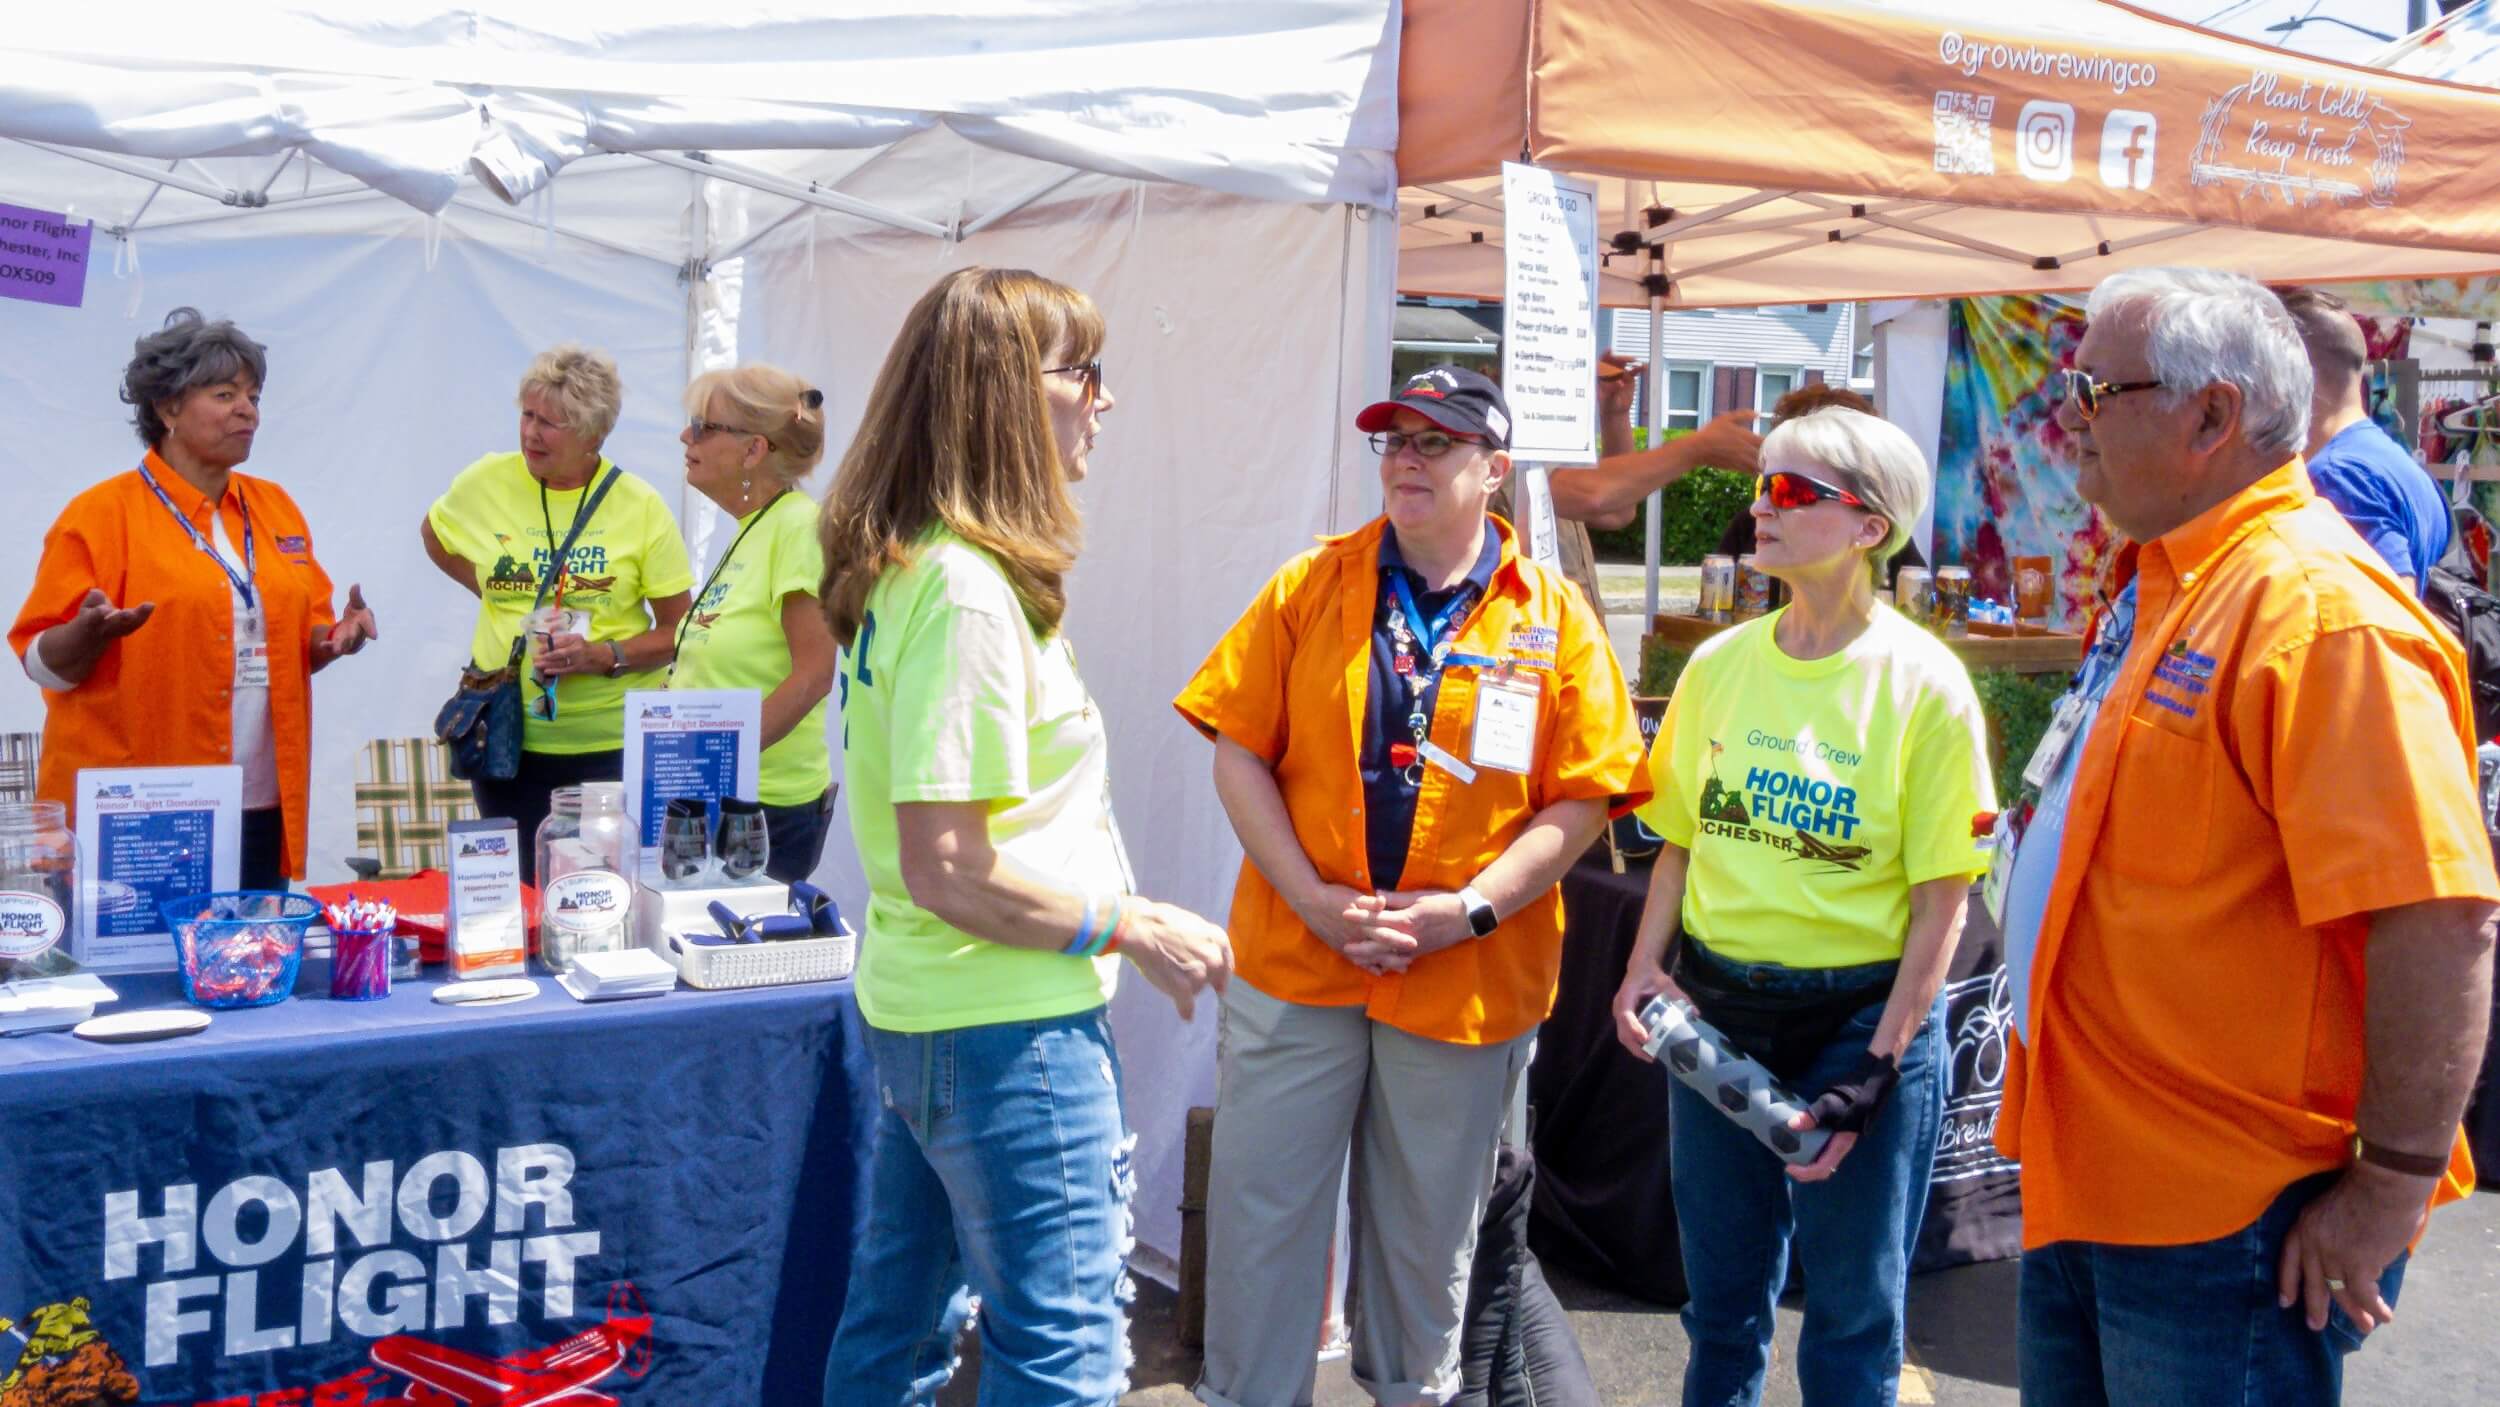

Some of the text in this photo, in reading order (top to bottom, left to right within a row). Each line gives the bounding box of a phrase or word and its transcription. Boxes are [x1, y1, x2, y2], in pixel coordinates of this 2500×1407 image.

[1940, 31, 2157, 95] @growbrewingco
[2247, 71, 2368, 120] Plant Cold
[2245, 119, 2354, 174] Reap Fresh
[1565, 198, 1577, 212] GO
[32, 219, 77, 238] Flight
[57, 247, 81, 263] Inc
[1515, 320, 1532, 331] Power
[532, 546, 606, 562] HNOR
[538, 559, 609, 578] FGHT
[672, 720, 697, 730] Flight
[699, 720, 745, 728] Donations
[1747, 729, 1862, 767] Ground Crew
[1745, 767, 1858, 814] HONOR
[96, 798, 221, 811] Honor Flight Donations
[1752, 793, 1861, 840] FLIGHT
[457, 871, 497, 882] Honoring
[464, 883, 509, 892] Hometown
[576, 889, 612, 899] HONOR
[473, 895, 502, 903] Heroes
[579, 896, 614, 907] FLIGHT
[1, 912, 42, 921] HONOR
[4, 920, 43, 929] FLIGHT
[104, 1142, 577, 1281] HONOR
[145, 1231, 600, 1367] FLIGHT
